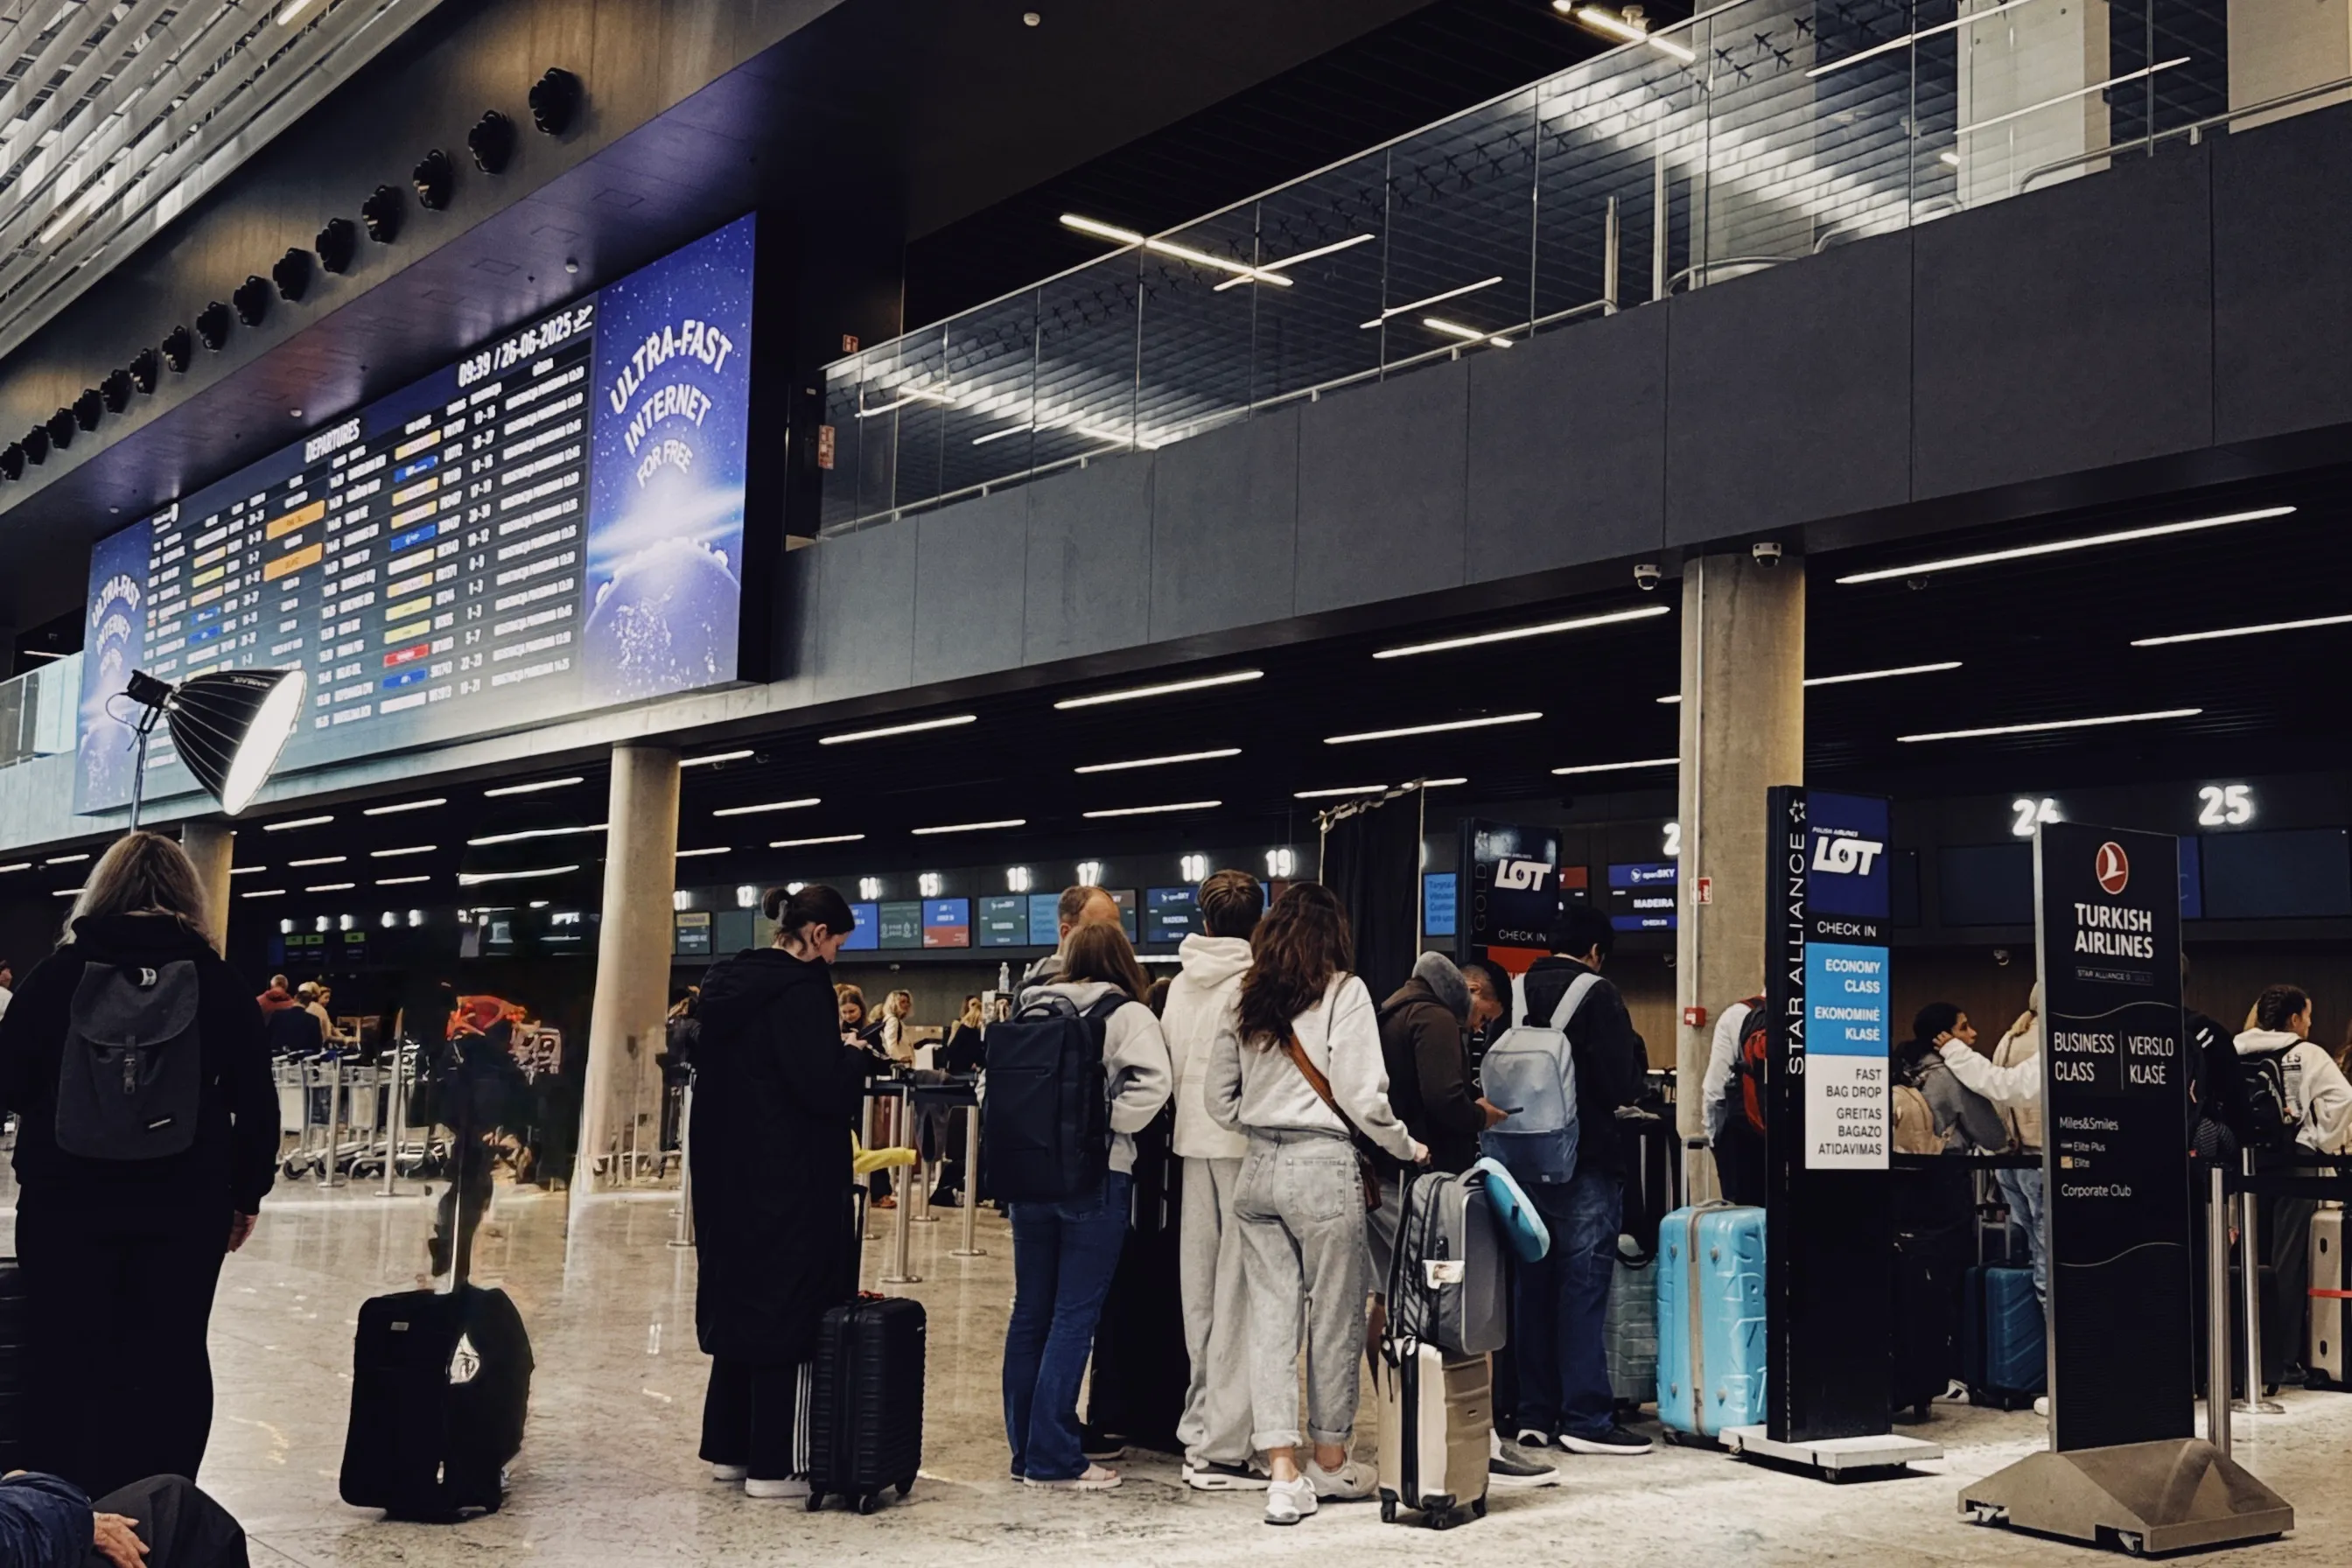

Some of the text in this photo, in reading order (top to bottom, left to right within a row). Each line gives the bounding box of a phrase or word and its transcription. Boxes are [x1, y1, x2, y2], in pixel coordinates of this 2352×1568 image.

[458, 352, 491, 388] 09:39
[500, 311, 571, 368] 26-06-2025
[610, 319, 733, 415] ULTRA-FAST
[624, 383, 712, 458] INTERNET
[305, 418, 360, 463] DEPARTURES
[636, 438, 693, 489] FOR FREE
[2198, 785, 2251, 825] 25
[1662, 822, 1681, 856] 2
[1265, 848, 1292, 878] 19
[1812, 836, 1883, 876] LOT
[1076, 862, 1100, 887] 17
[1180, 855, 1205, 882] 18
[1494, 858, 1552, 892] LOT
[919, 872, 939, 897] 15
[673, 890, 688, 911] 11
[737, 886, 754, 907] 12
[1474, 863, 1488, 931] GOLD
[1633, 899, 1675, 908] MADEIRA
[1817, 920, 1876, 937] CHECK IN
[2075, 902, 2152, 933] TURKISH
[1498, 929, 1547, 942] CHECK IN
[2075, 929, 2153, 959] AIRLINES
[1788, 832, 1805, 1075] STAR ALLIANCE
[1825, 958, 1880, 974] ECONOMY
[1844, 979, 1880, 994] CLASS
[1815, 1006, 1880, 1022] EKONOMINĖ
[1845, 1026, 1880, 1041] KLASĖ
[2054, 1032, 2115, 1054] BUSINESS
[2128, 1036, 2174, 1057] VERSLO
[1856, 1068, 1882, 1081] FAST
[2054, 1060, 2095, 1082] CLASS
[2129, 1061, 2166, 1084] KLASĖ
[1826, 1086, 1881, 1098] BAG DROP
[1836, 1107, 1881, 1120] GREITAS
[2060, 1116, 2119, 1130] Miles&Smiles
[1818, 1143, 1882, 1155] ATIDAVIMAS
[2074, 1141, 2106, 1152] Elite Plus
[2074, 1158, 2090, 1168] Elite
[2061, 1183, 2132, 1199] Corporate Club
